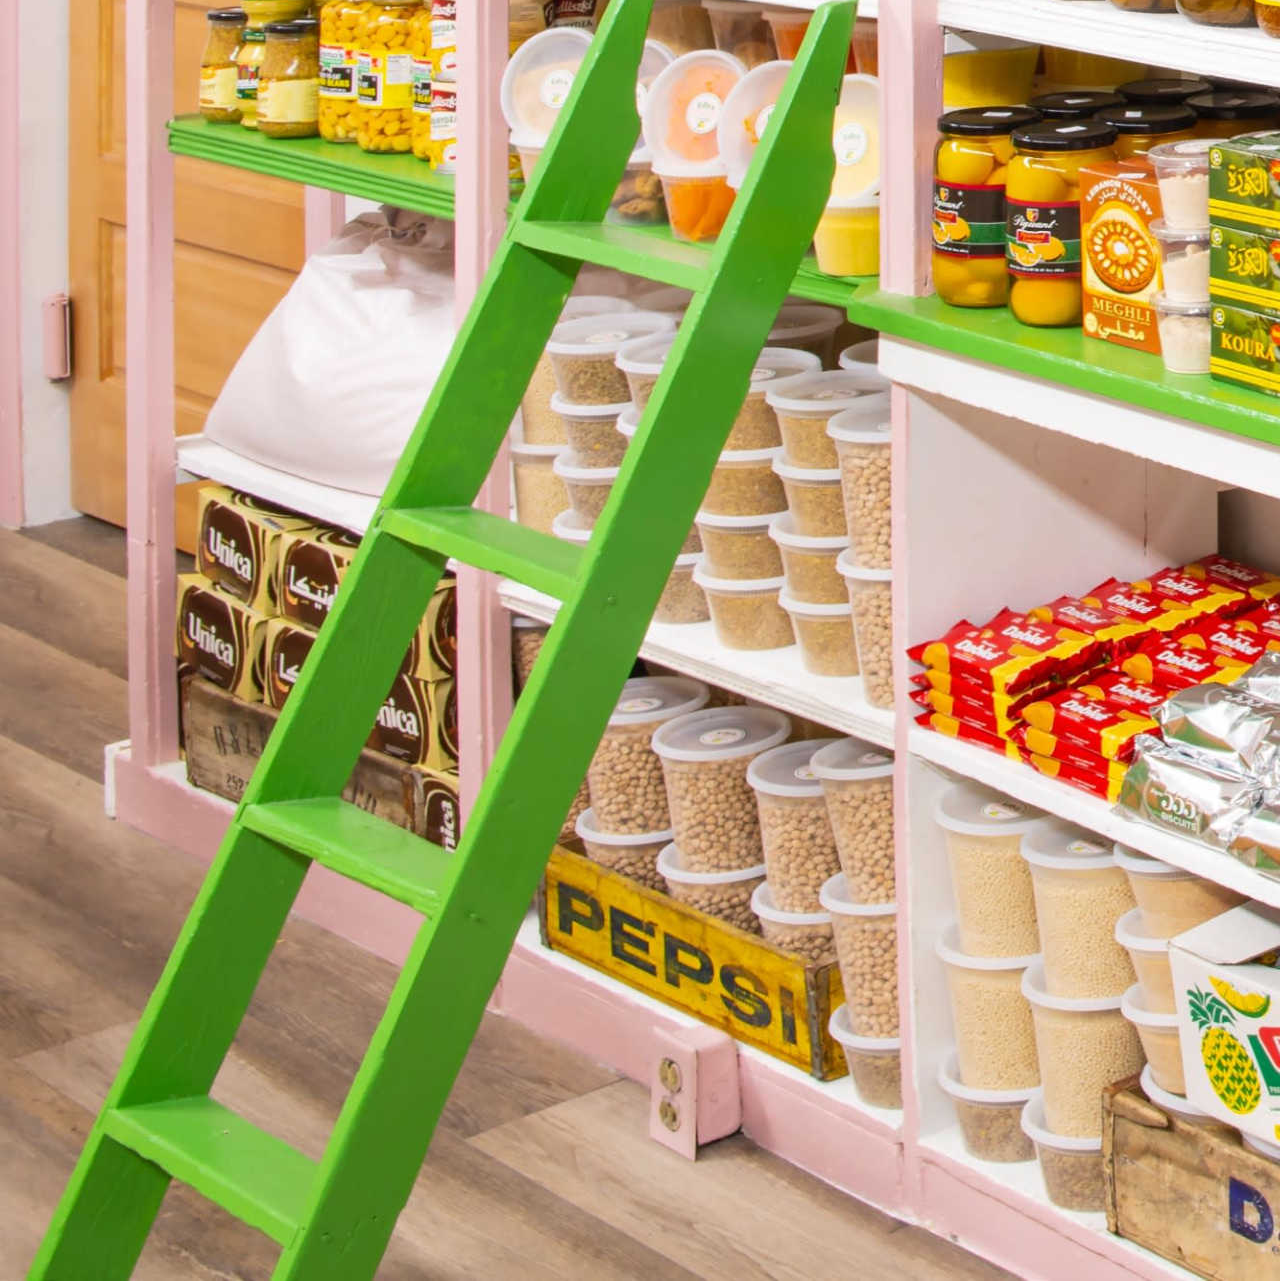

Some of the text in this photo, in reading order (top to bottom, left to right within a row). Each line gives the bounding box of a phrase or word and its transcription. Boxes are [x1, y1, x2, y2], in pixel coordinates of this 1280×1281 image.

[1086, 180, 1152, 215] LEBANON VALLEY
[1092, 297, 1150, 323] MEGHLI
[1220, 332, 1276, 363] KOURA
[208, 526, 252, 581] Unica
[188, 612, 235, 667] Unica
[556, 880, 798, 1047] PEPSI
[1227, 1175, 1275, 1244] D
